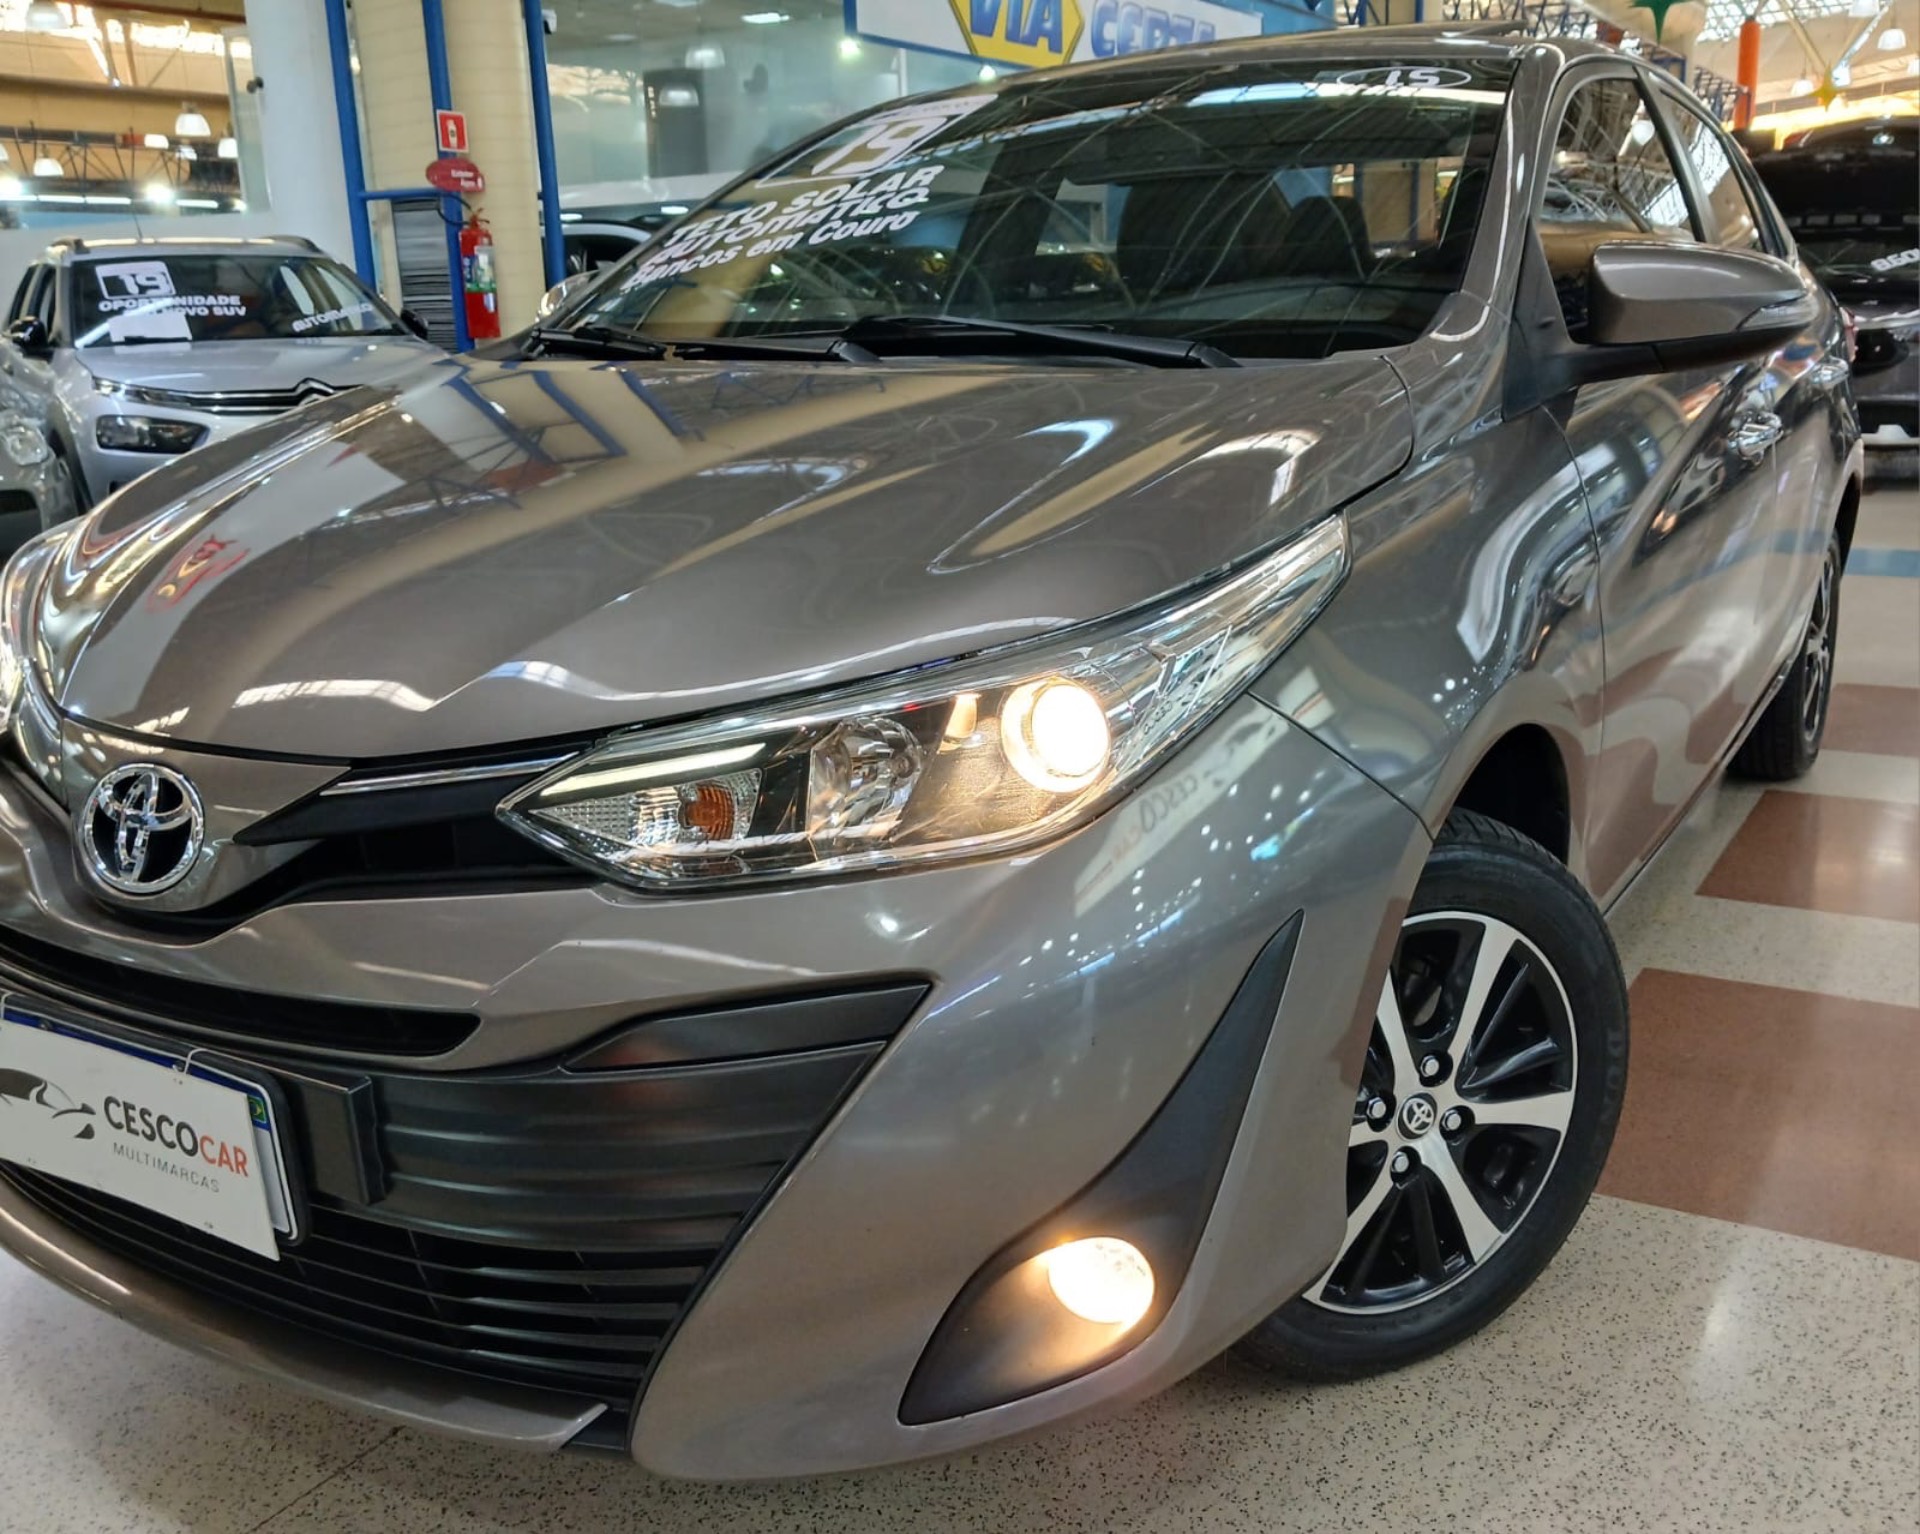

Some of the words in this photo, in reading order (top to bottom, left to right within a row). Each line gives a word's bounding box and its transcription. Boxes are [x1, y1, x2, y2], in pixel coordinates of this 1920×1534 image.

[812, 117, 948, 175] 19
[664, 201, 778, 248] TETO
[782, 165, 945, 214] SOLAR
[620, 245, 743, 295] Bancos
[747, 232, 804, 257] em
[809, 211, 920, 245] Couro
[98, 294, 241, 312] OPORNIDADE
[118, 272, 171, 295] 19
[212, 306, 247, 316] SUV
[104, 1096, 248, 1177] CESCOCAR
[113, 1142, 220, 1193] MULTIMARCAS
